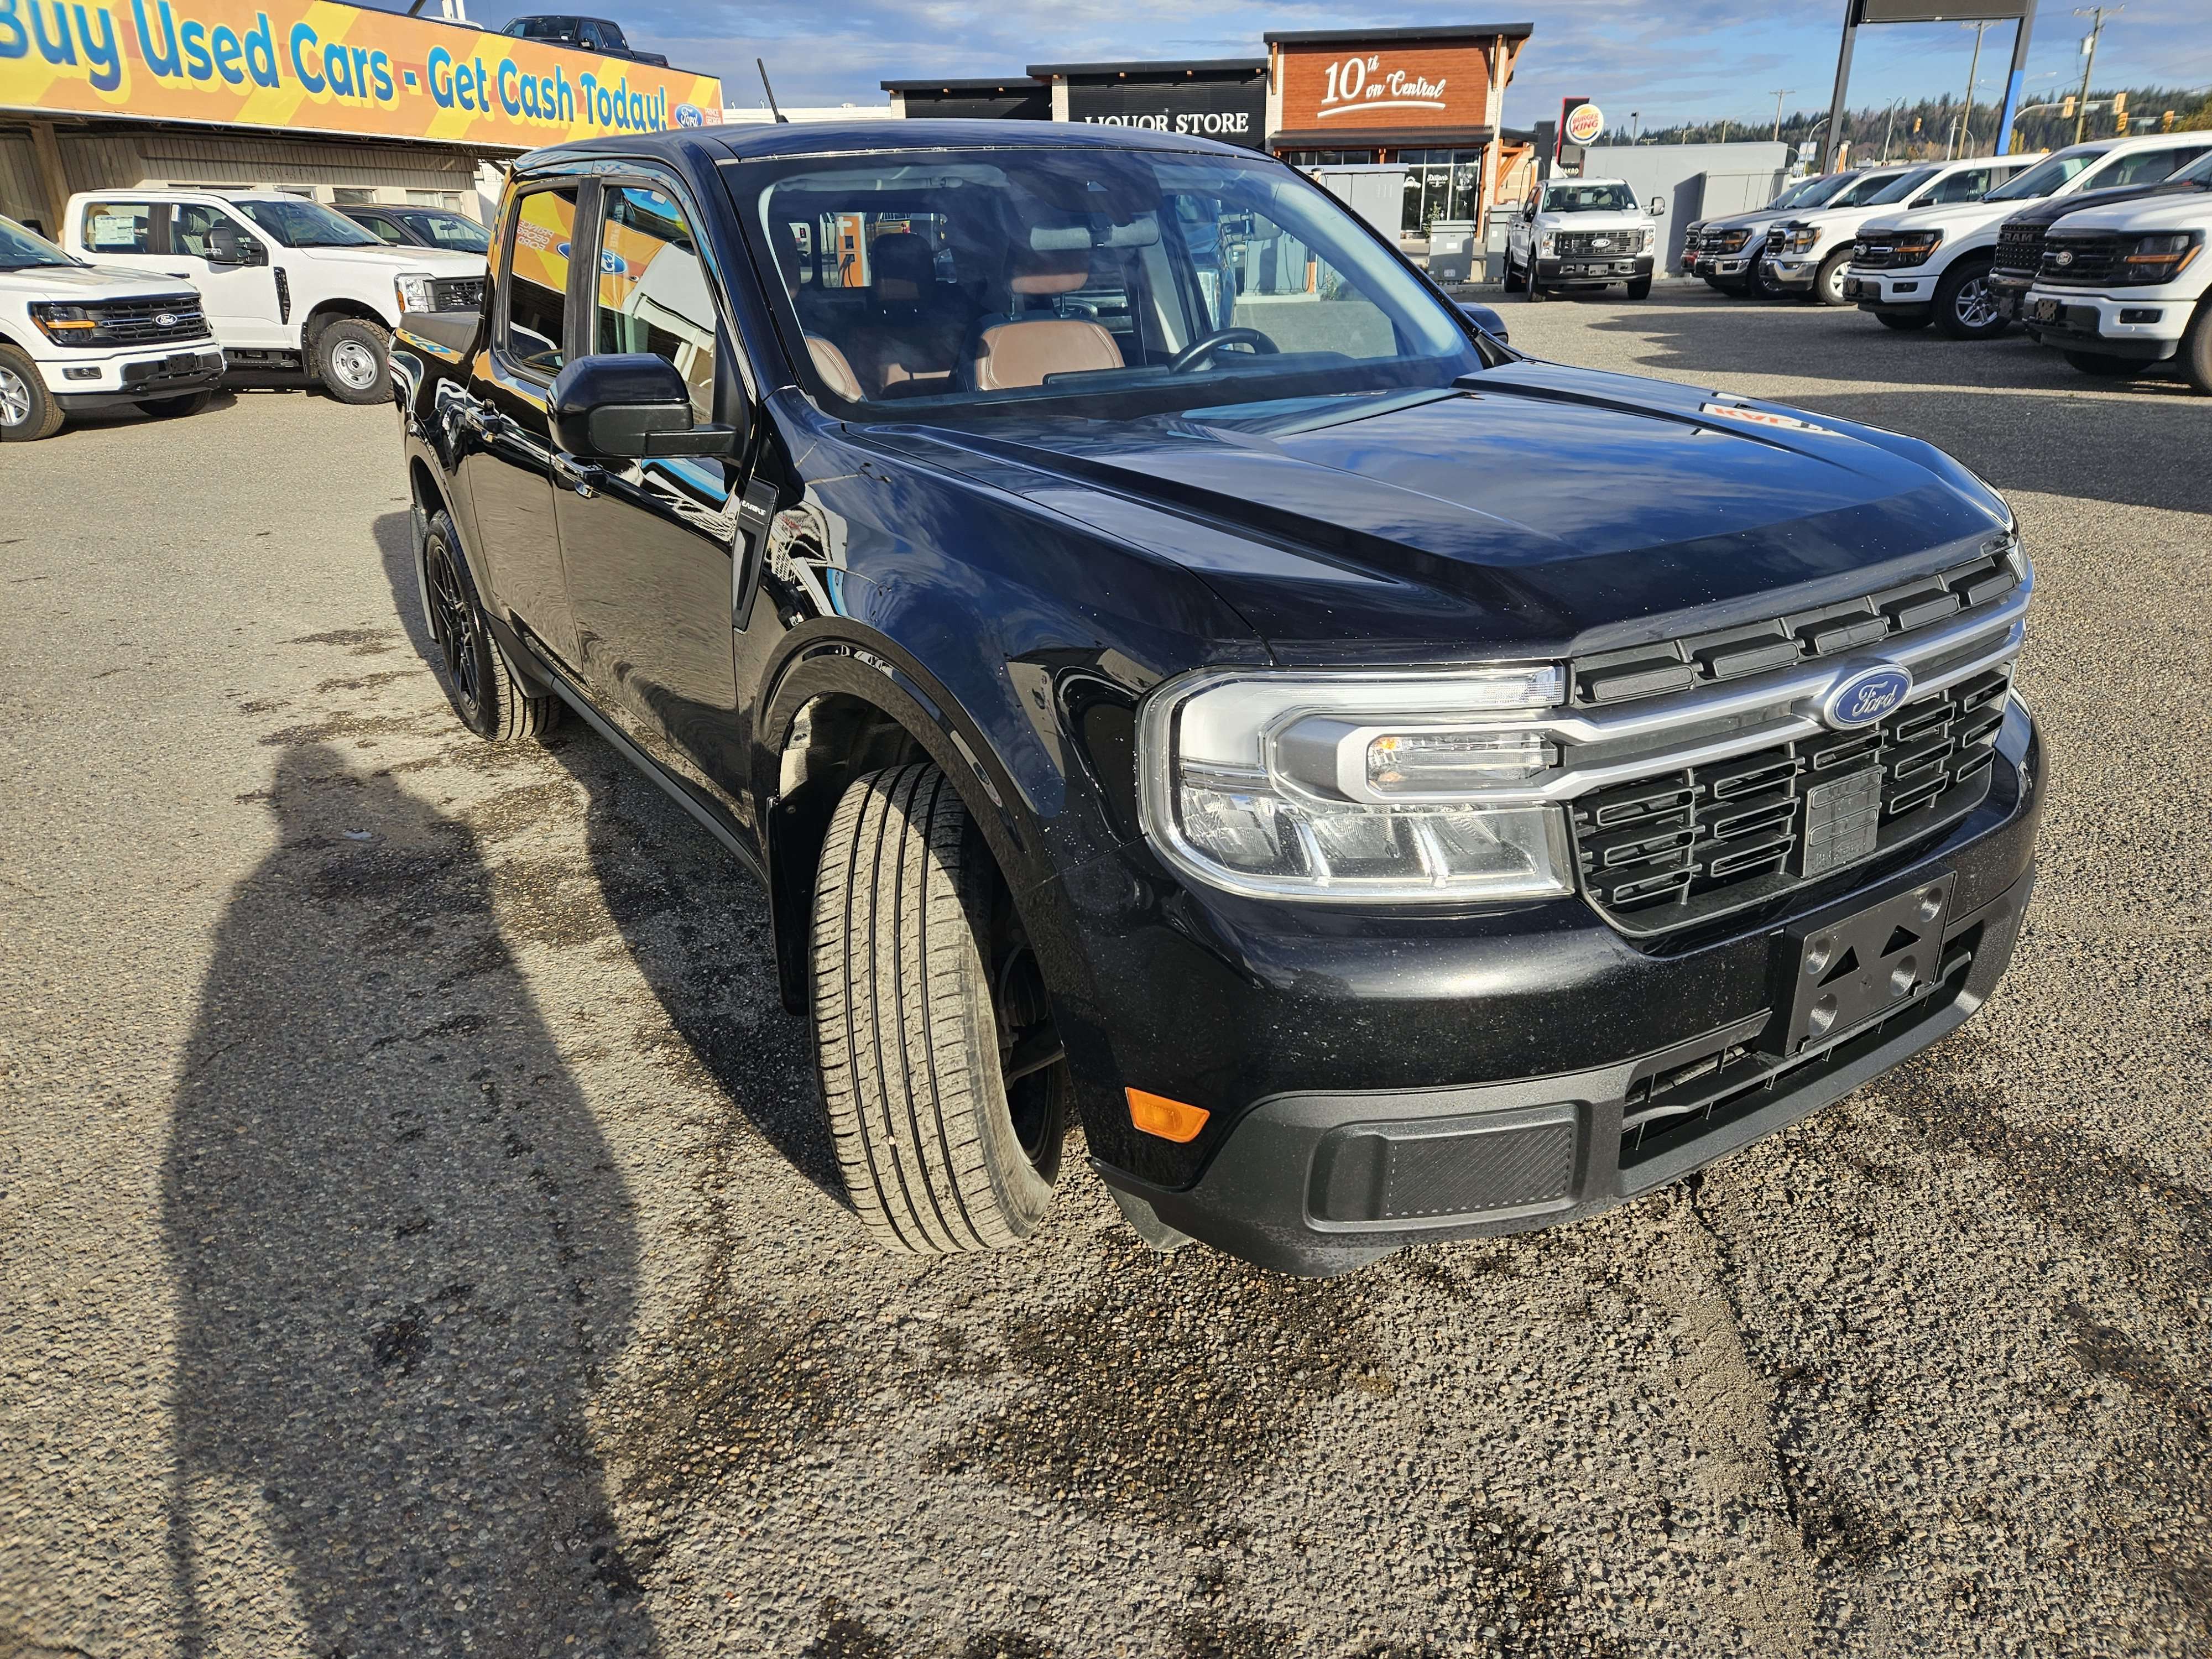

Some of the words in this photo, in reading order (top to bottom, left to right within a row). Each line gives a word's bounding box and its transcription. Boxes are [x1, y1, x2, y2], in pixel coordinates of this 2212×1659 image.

[129, 0, 280, 88] Used
[290, 23, 393, 101] Cars
[429, 46, 489, 113] Get
[498, 58, 574, 122] Cash
[581, 72, 667, 132] Today!
[1366, 84, 1385, 99] on
[1386, 70, 1446, 98] Central
[680, 107, 698, 127] Ford
[1176, 113, 1249, 134] STORE
[1572, 119, 1598, 133] KING
[1573, 113, 1598, 124] BURGER
[2004, 233, 2033, 242] RAM
[1852, 681, 1898, 717] Ford
